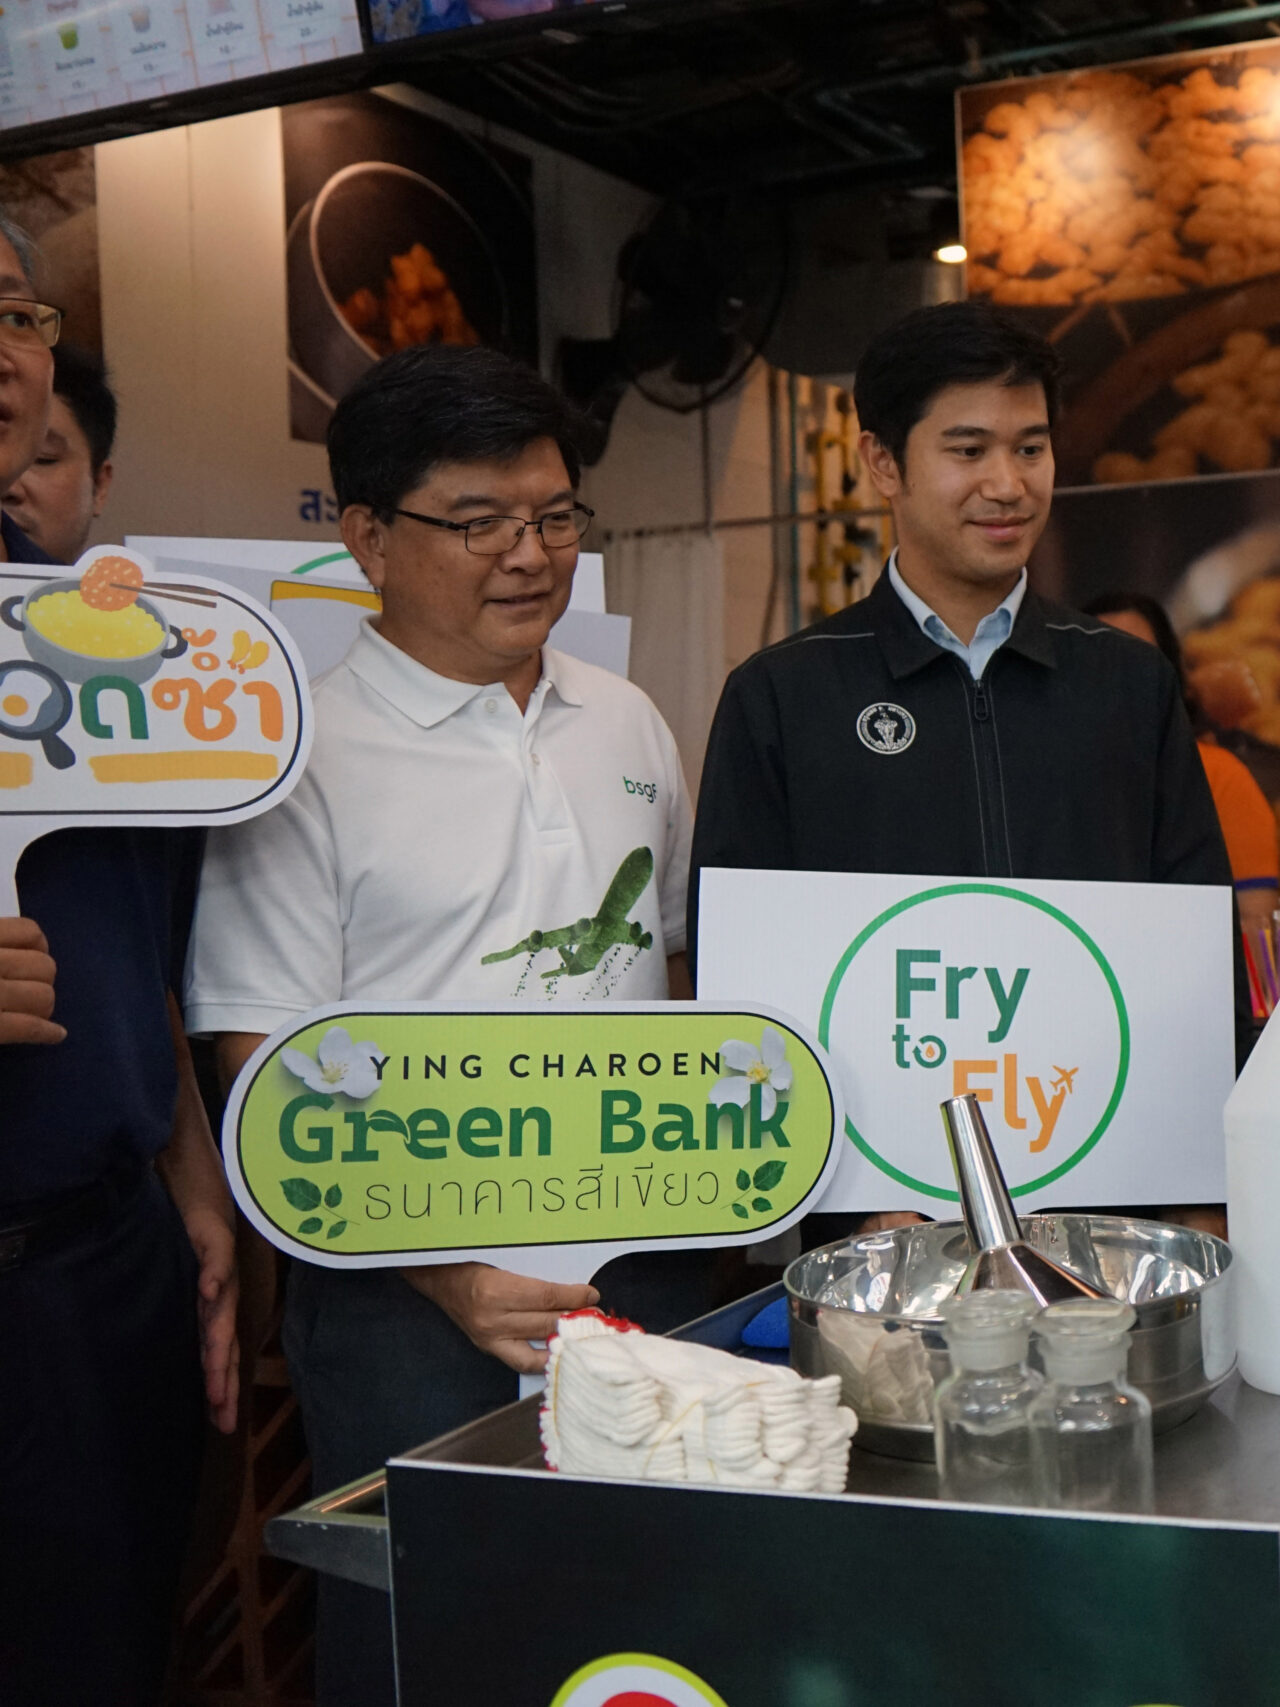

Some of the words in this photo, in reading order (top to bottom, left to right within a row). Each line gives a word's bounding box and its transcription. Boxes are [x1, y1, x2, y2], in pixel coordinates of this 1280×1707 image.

[895, 948, 1031, 1043] Fry
[369, 1054, 482, 1081] YING
[509, 1052, 721, 1079] CHAROEN
[892, 1024, 947, 1069] to
[279, 1092, 552, 1164] Green
[600, 1083, 792, 1155] Bank
[953, 1053, 1074, 1154] Fly
[366, 1162, 719, 1221] ธนาคารสีเขียว
